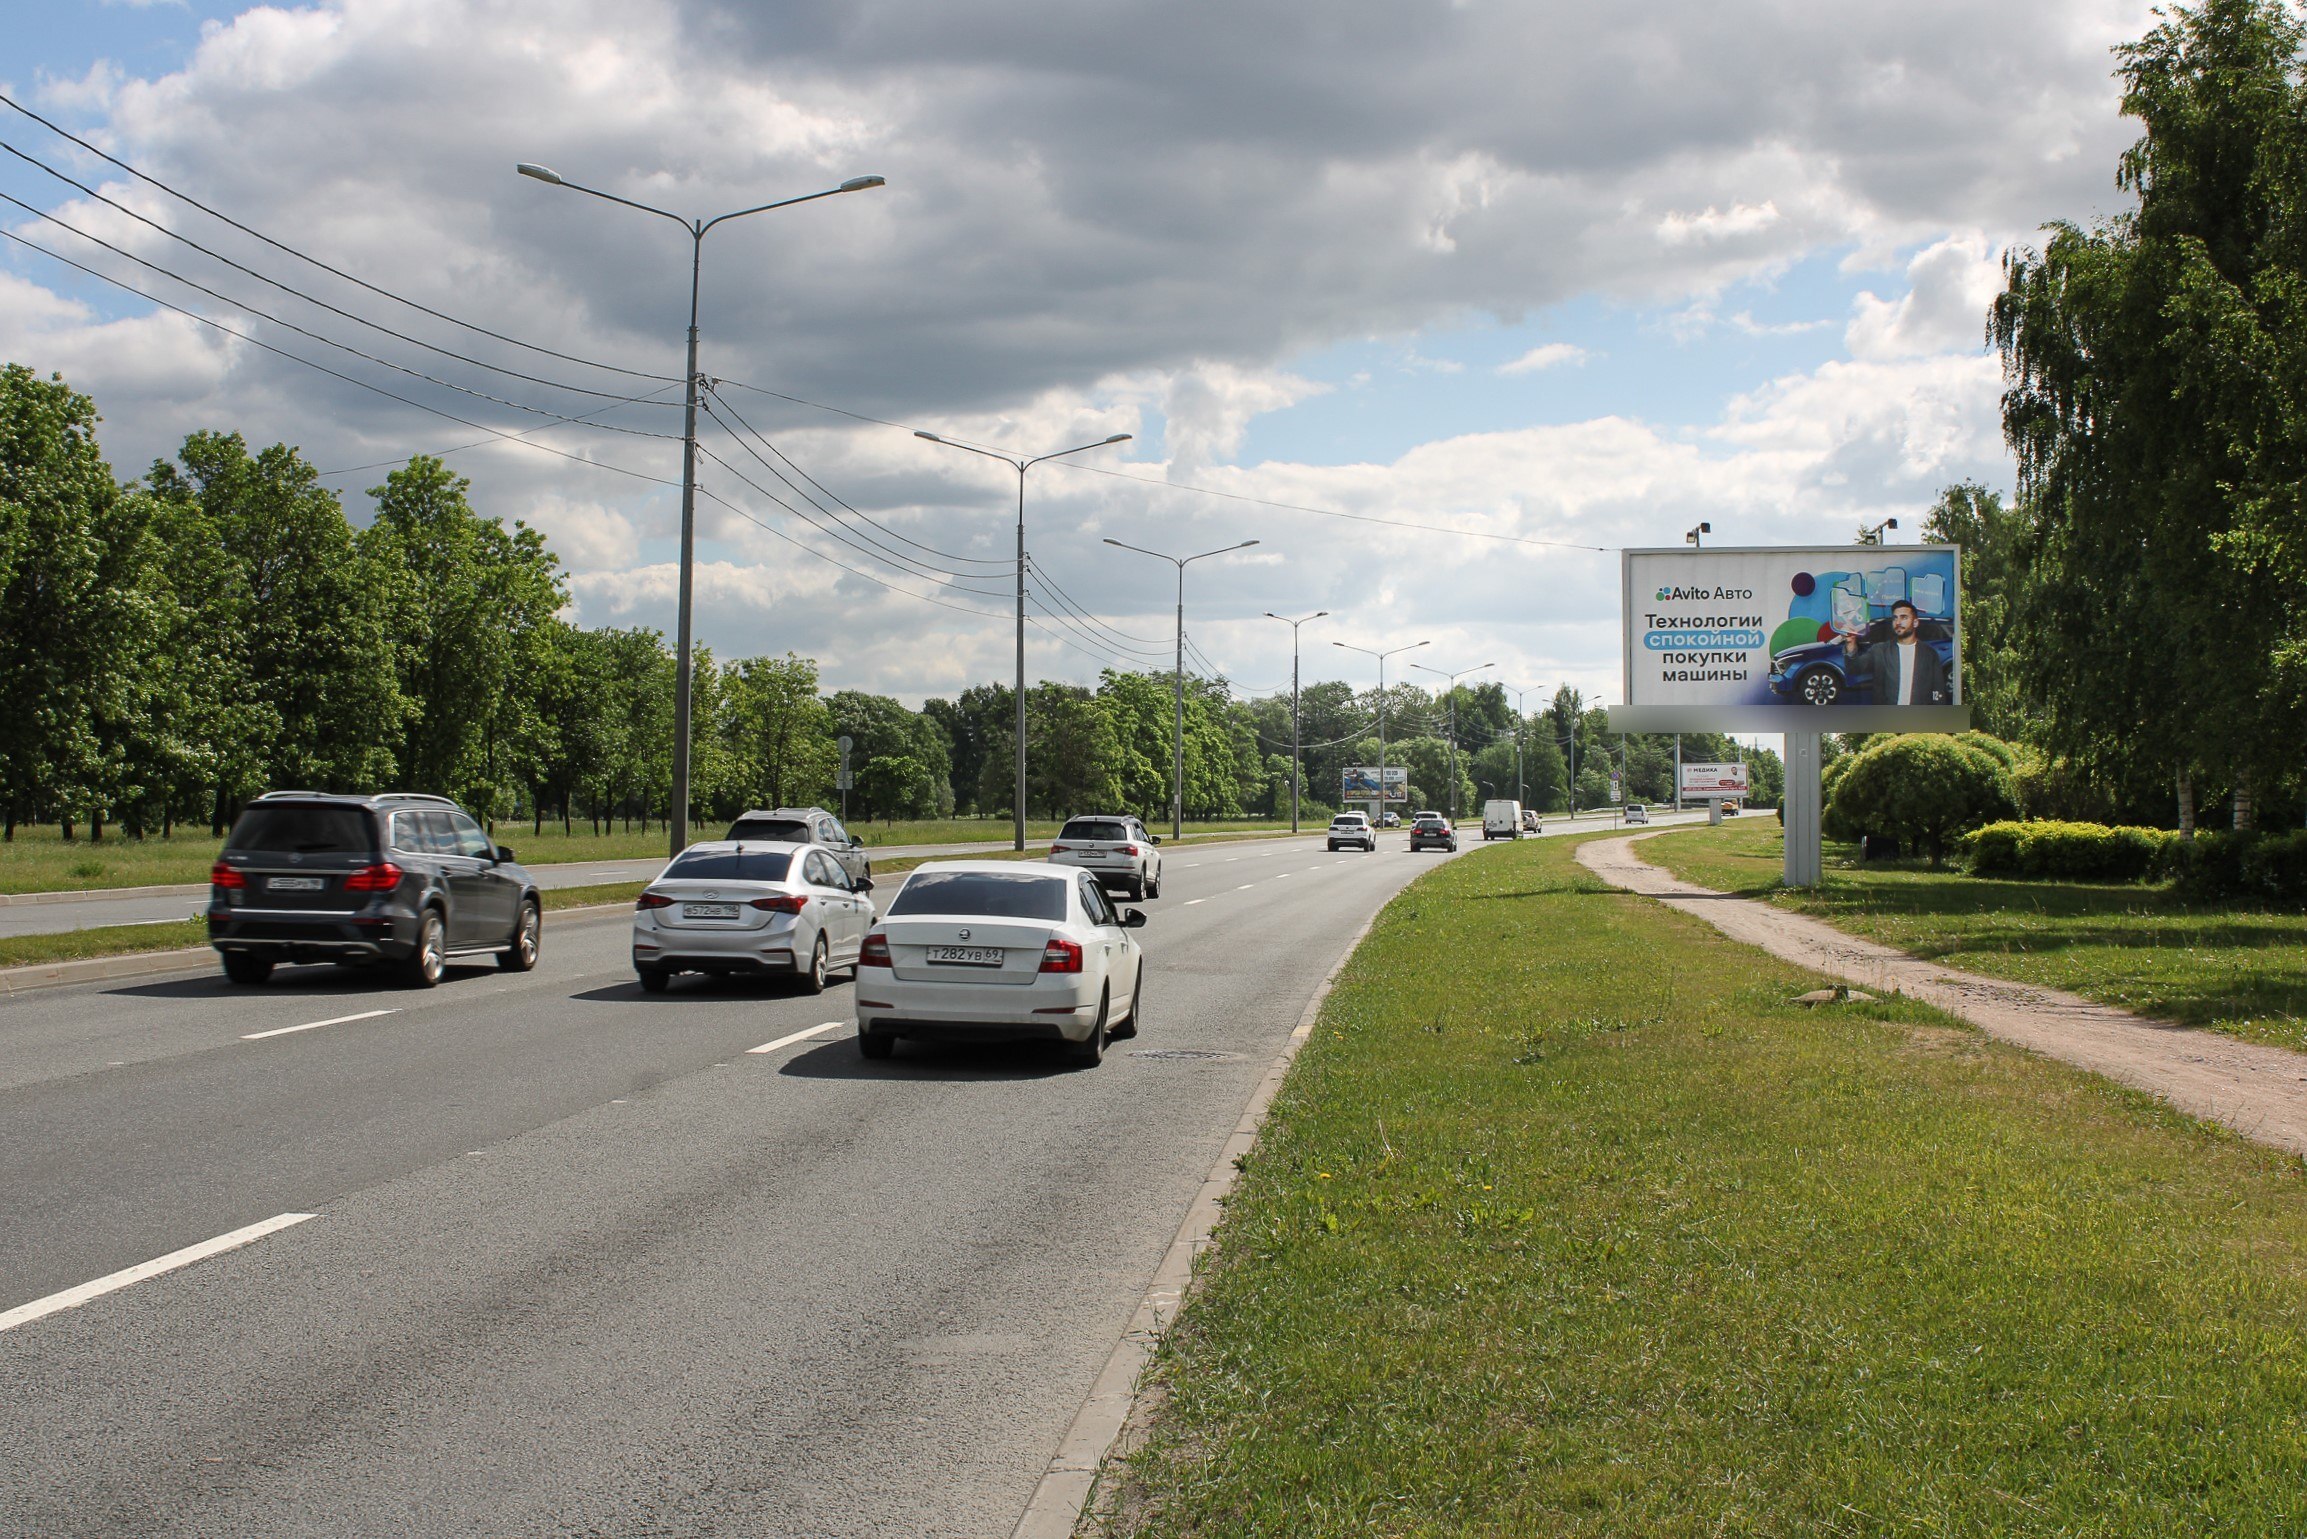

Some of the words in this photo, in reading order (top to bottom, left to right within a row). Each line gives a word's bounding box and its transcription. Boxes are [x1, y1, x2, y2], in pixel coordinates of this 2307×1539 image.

[1671, 586, 1710, 600] Avito
[1713, 586, 1753, 600] Авто
[1644, 613, 1763, 629] Технологии
[1649, 629, 1760, 647] спокойной
[1662, 651, 1747, 668] покупки
[1662, 669, 1748, 682] машины
[985, 948, 998, 959] 69
